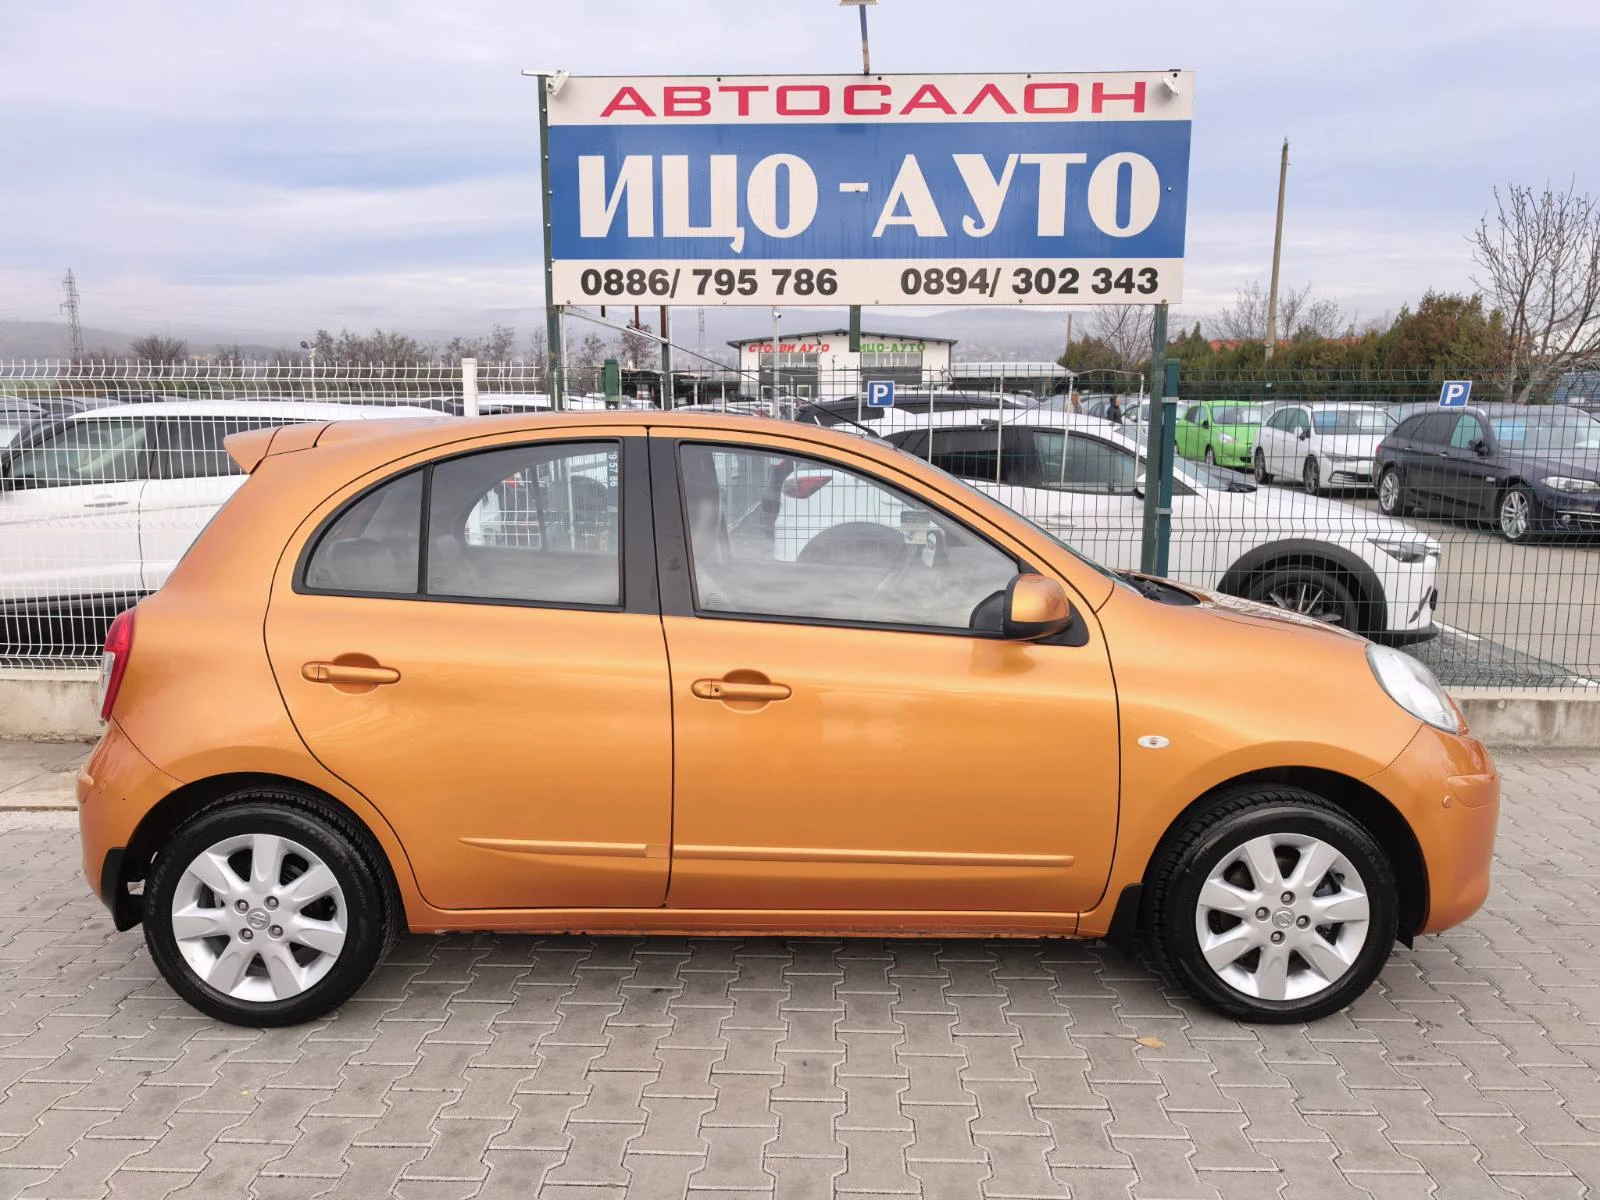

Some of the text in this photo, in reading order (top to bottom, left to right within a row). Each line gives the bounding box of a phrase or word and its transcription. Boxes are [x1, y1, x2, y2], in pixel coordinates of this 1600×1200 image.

[600, 82, 1146, 118] АВТОСАЛОН
[580, 268, 838, 299] 0886/ 795 786
[900, 267, 1159, 299] 0894/ 302 343
[872, 383, 889, 404] P
[1444, 384, 1464, 405] P
